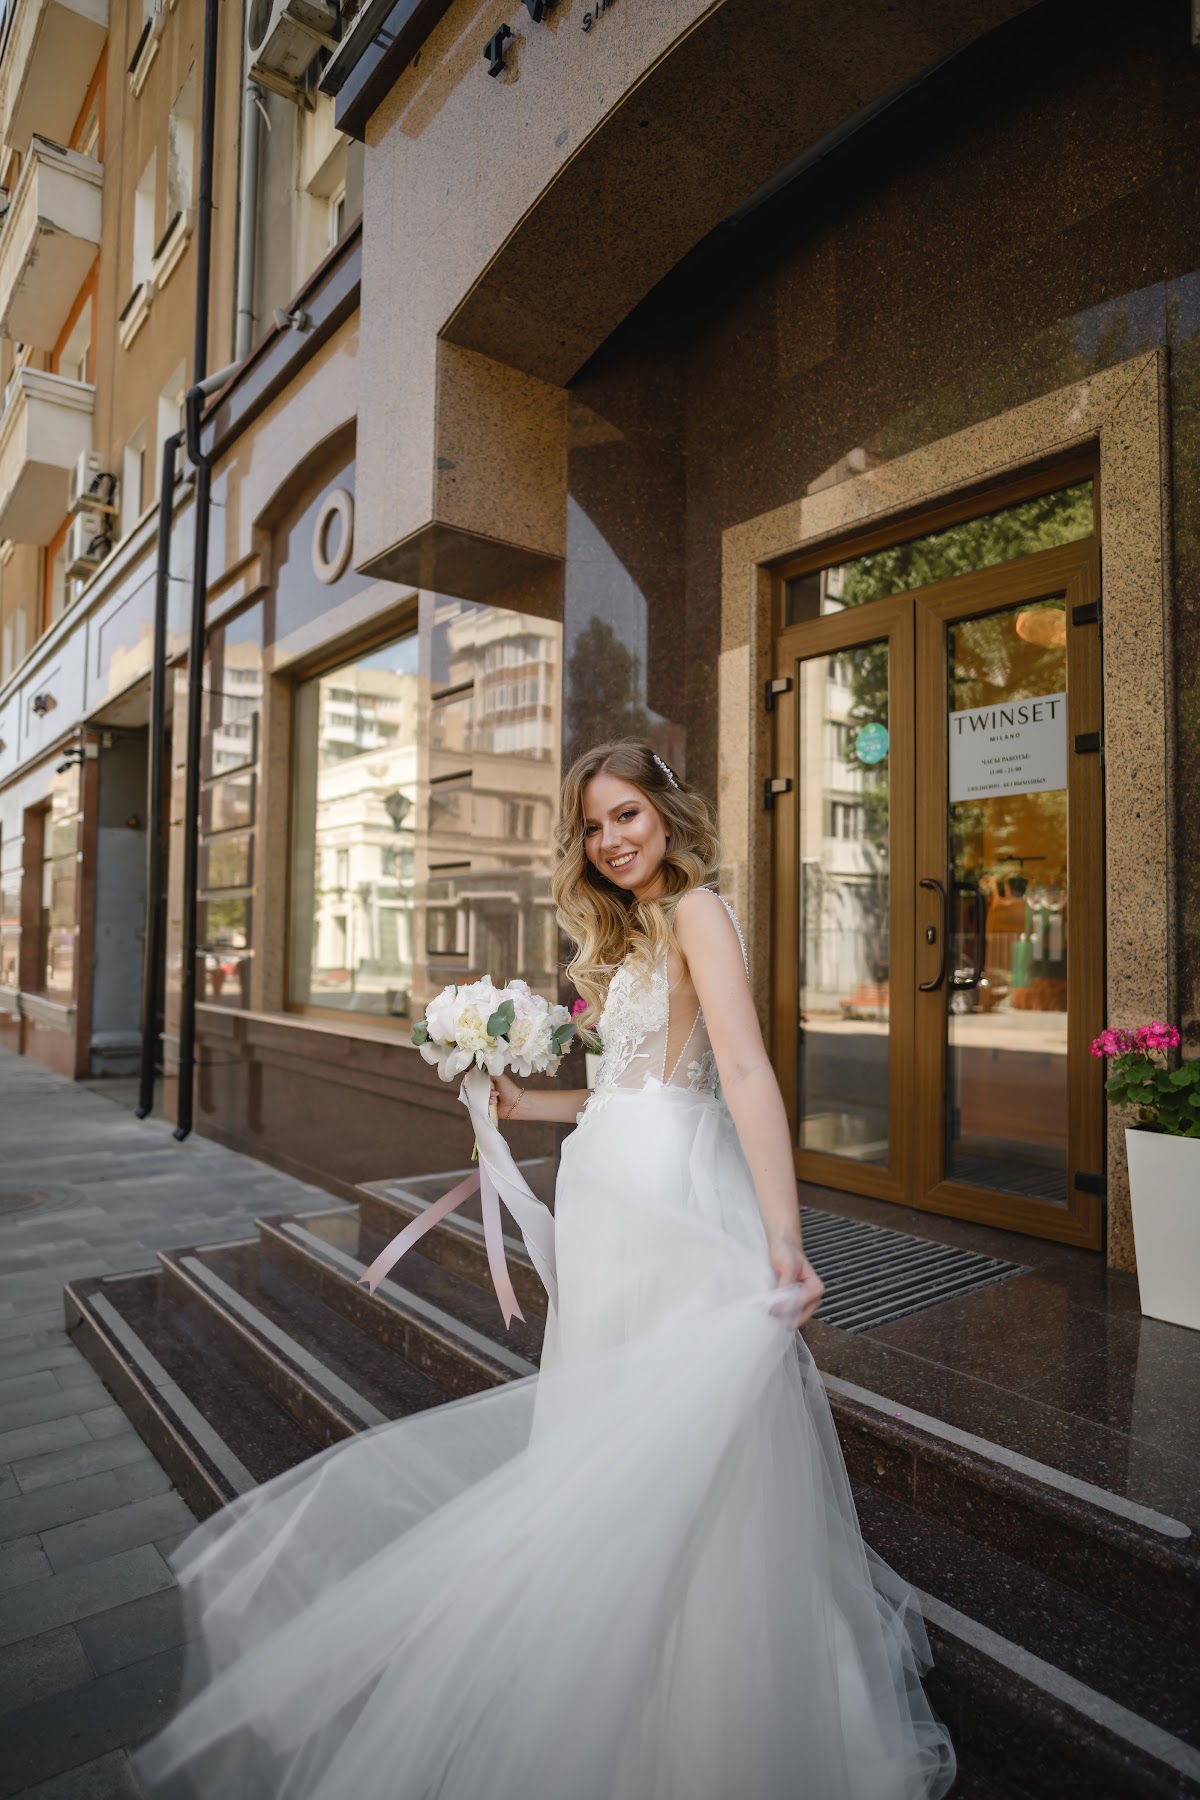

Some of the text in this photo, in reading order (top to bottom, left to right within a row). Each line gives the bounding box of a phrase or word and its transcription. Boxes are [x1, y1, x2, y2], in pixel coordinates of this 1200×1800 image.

[953, 699, 1061, 735] TWINSET
[989, 733, 1021, 742] MILANO
[981, 757, 1000, 765] ЧАСЫ
